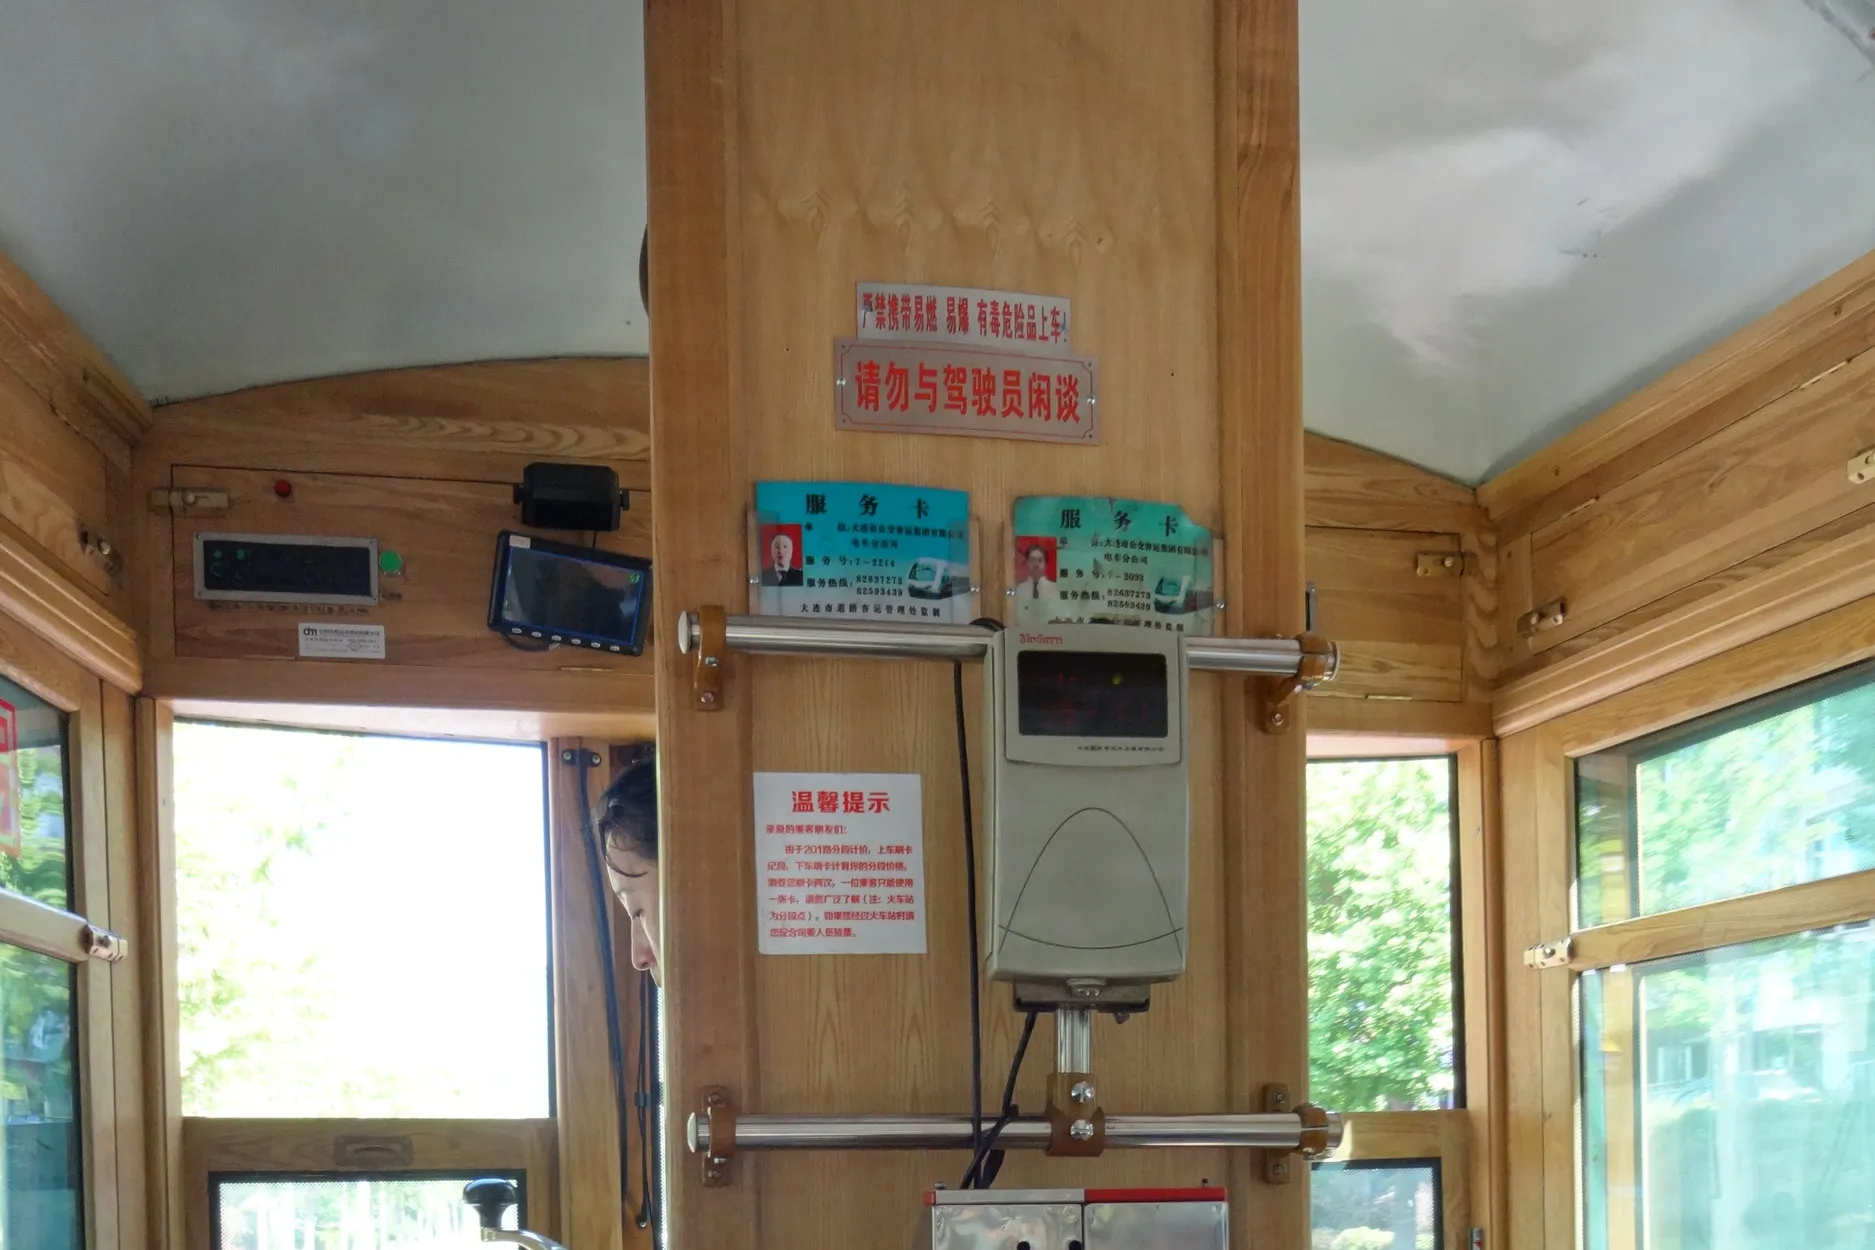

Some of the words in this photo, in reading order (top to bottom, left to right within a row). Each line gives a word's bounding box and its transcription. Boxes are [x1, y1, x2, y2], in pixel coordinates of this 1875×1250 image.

[855, 360, 1080, 423] 请勿与驾驶员闲谈
[805, 493, 930, 519] 服务卡
[1060, 509, 1179, 537] 服务卡
[792, 790, 890, 813] 温馨提示
